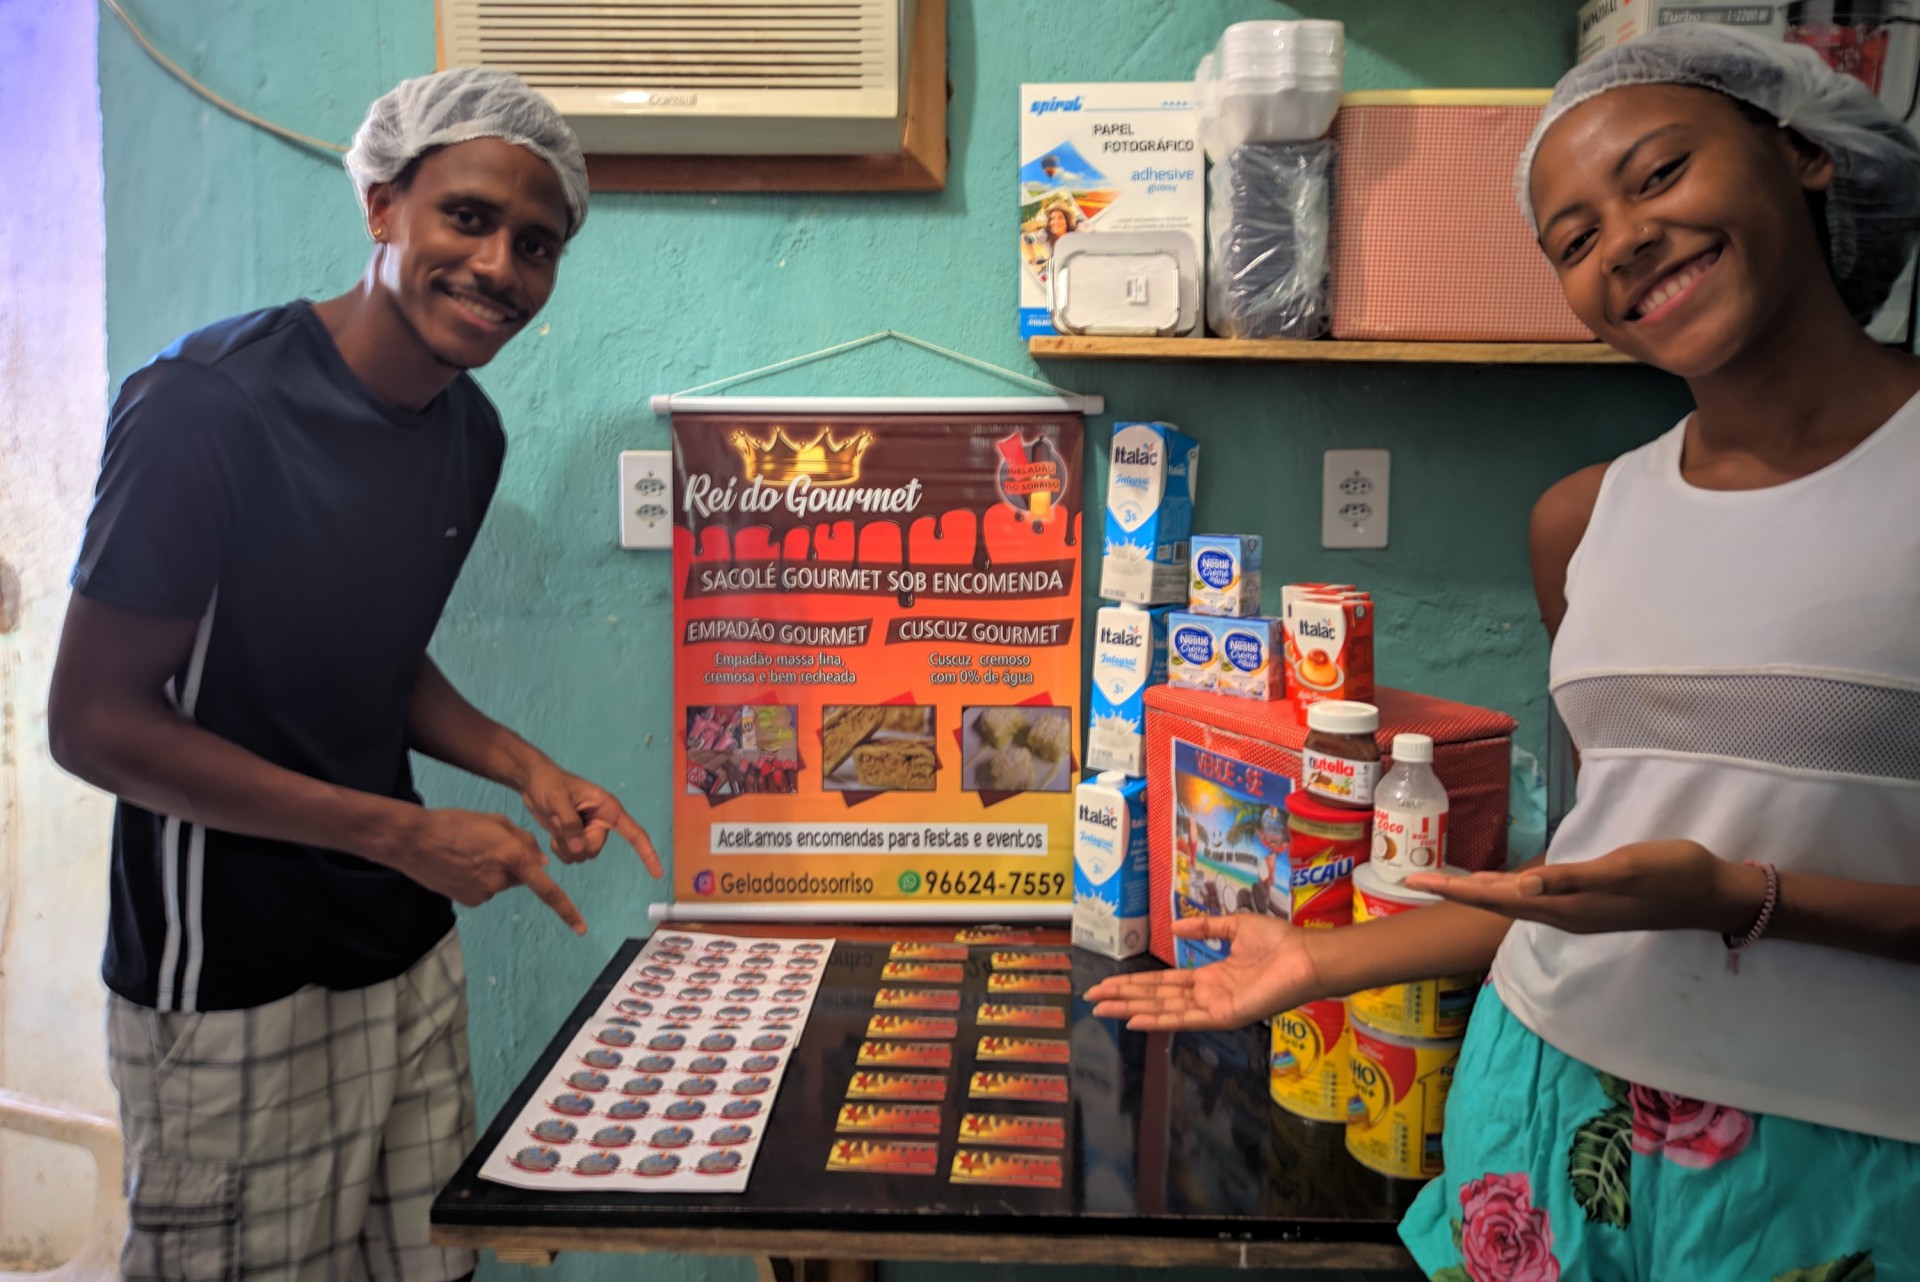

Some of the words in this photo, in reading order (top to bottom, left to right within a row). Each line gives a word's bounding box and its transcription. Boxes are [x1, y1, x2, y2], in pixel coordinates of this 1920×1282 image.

[1030, 96, 1083, 116] spiral
[1094, 124, 1134, 135] PAPEL
[1104, 138, 1194, 151] FOTOGRÁFICO
[1131, 167, 1194, 181] adhesive
[1115, 446, 1157, 465] Italac
[683, 474, 738, 517] Rei
[741, 475, 783, 512] do
[784, 475, 922, 518] Gourmet
[1202, 558, 1229, 568] Nestlé
[701, 562, 775, 592] SACOLÉ
[782, 566, 881, 590] GOURMET
[887, 570, 927, 593] SOB
[932, 570, 1063, 594] ENCOMENDA
[687, 617, 775, 642] EMPADÃO
[781, 622, 867, 645] GOURMET
[899, 620, 967, 642] CUSCUZ
[972, 623, 1059, 645] GOURMET
[1100, 627, 1142, 647] Italac
[1299, 619, 1336, 640] Italac
[1180, 635, 1208, 645] Nestlé
[1230, 640, 1258, 652] Nestlé
[714, 652, 772, 669] Empadão
[776, 655, 815, 667] massa
[928, 652, 971, 668] Cuscuz
[979, 655, 1031, 667] cremoso
[703, 671, 755, 685] cremosa
[759, 672, 766, 684] e
[769, 669, 795, 684] bem
[799, 669, 857, 685] recheada
[930, 672, 955, 684] com
[958, 669, 981, 684] 0%
[983, 669, 999, 684] de
[1001, 669, 1034, 688] água
[1309, 756, 1354, 776] nutella
[1079, 805, 1117, 829] Italac
[1378, 820, 1403, 833] COCO
[718, 827, 793, 848] Aceitamos
[797, 829, 884, 848] encomendas
[888, 832, 921, 851] para
[924, 828, 969, 848] festas
[973, 833, 982, 848] e
[986, 830, 1043, 849] eventos
[1292, 856, 1354, 887] ESCAU
[720, 872, 874, 896] Geladaodosorriso
[925, 870, 1065, 895] 96624-7559
